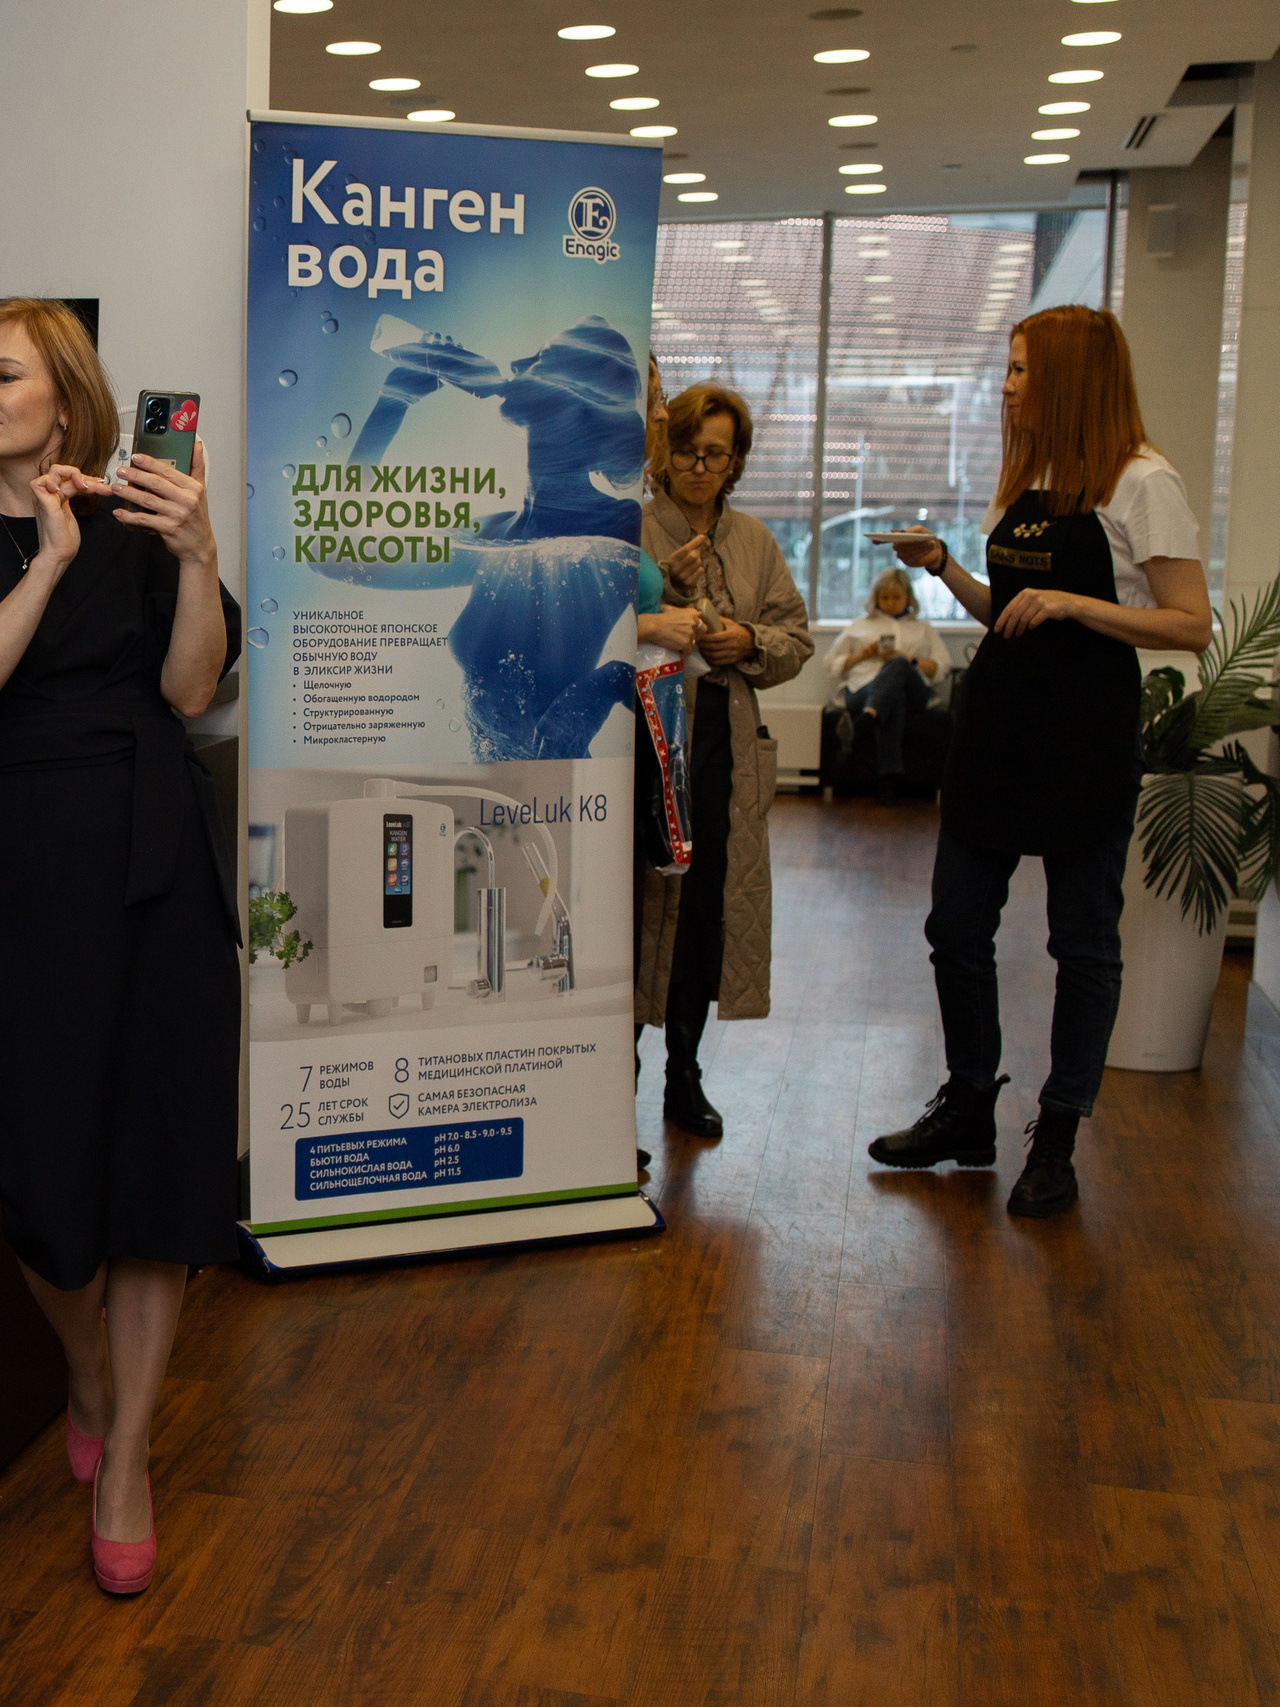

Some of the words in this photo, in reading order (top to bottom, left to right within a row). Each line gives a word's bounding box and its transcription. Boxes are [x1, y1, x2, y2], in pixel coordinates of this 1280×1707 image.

[291, 158, 525, 235] Канген
[565, 238, 617, 261] Enagic
[287, 244, 445, 300] вода
[292, 464, 362, 496] ДЛЯ
[369, 465, 507, 499] ЖИЗНИ,
[293, 499, 481, 533] ЗДОРОВЬЯ,
[295, 535, 450, 564] КРАСОТЫ
[293, 611, 364, 620] УНИКАЛЬНОЕ
[293, 625, 378, 634] ВЫСОКОТОЧНОЕ
[380, 624, 438, 633] ЯПОНСКОЕ
[293, 638, 378, 648] ОБОРУДОВАНИЕ
[380, 637, 448, 648] ПРЕВРАЩАЕТ
[293, 652, 348, 662] ОБЫЧНУЮ
[350, 652, 378, 661] ВОДУ
[293, 667, 300, 676] В
[304, 666, 352, 676] ЭЛИКСИР
[354, 665, 393, 675] ЖИЗНИ
[303, 680, 352, 691] Щелочную
[303, 693, 366, 704] Обогащенную
[368, 693, 420, 703] водородом
[303, 707, 394, 719] Структурированную
[303, 721, 367, 732] Отрицательно
[368, 721, 426, 731] заряженную
[303, 735, 387, 747] Микрокластерную
[480, 795, 571, 826] LeveLuk
[580, 794, 607, 822] K8
[418, 1052, 484, 1067] ТИТАНОВЫХ
[485, 1048, 536, 1061] ПЛАСТИН
[537, 1043, 597, 1057] ПОКРЫТЫХ
[320, 1061, 374, 1075] РЕЖИМОВ
[394, 1057, 410, 1083] 8
[418, 1063, 502, 1081] МЕДИЦИНСКОЙ
[504, 1058, 563, 1073] ПЛАТИНОЙ
[299, 1065, 313, 1092] 7
[320, 1077, 350, 1090] ВОДЫ
[418, 1090, 455, 1102] САМАЯ
[457, 1083, 526, 1099] БЕЗОПАСНАЯ
[317, 1101, 339, 1112] ЛЕТ
[339, 1098, 369, 1110] СРОК
[418, 1103, 460, 1117] КАМЕРА
[461, 1096, 538, 1112] ЭЛЕКТРОЛИЗА
[280, 1101, 311, 1130] 25
[317, 1112, 364, 1126] СЛУЖБЫ
[434, 1133, 446, 1144] pH
[448, 1131, 459, 1141] 7.0
[464, 1130, 477, 1139] 8.5
[482, 1128, 495, 1138] 9.0
[500, 1127, 513, 1136] 9.5
[310, 1146, 316, 1154] 4
[317, 1140, 365, 1154] ПИТЬЕВЫХ
[366, 1137, 408, 1149] РЕЖИМА
[434, 1145, 446, 1156] pH
[447, 1143, 460, 1153] 6.0
[310, 1157, 343, 1167] БЬЮТИ
[344, 1153, 370, 1164] ВОДА
[434, 1157, 446, 1168] pH
[447, 1155, 460, 1165] 2.5
[310, 1163, 386, 1179] СИЛЬНОКИСЛАЯ
[387, 1160, 413, 1172] ВОДА
[434, 1169, 446, 1180] pH
[448, 1167, 462, 1177] 11.5
[309, 1174, 401, 1191] СИЛЬНОЩЕЛОЧНАЯ
[402, 1171, 428, 1183] ВОДА
